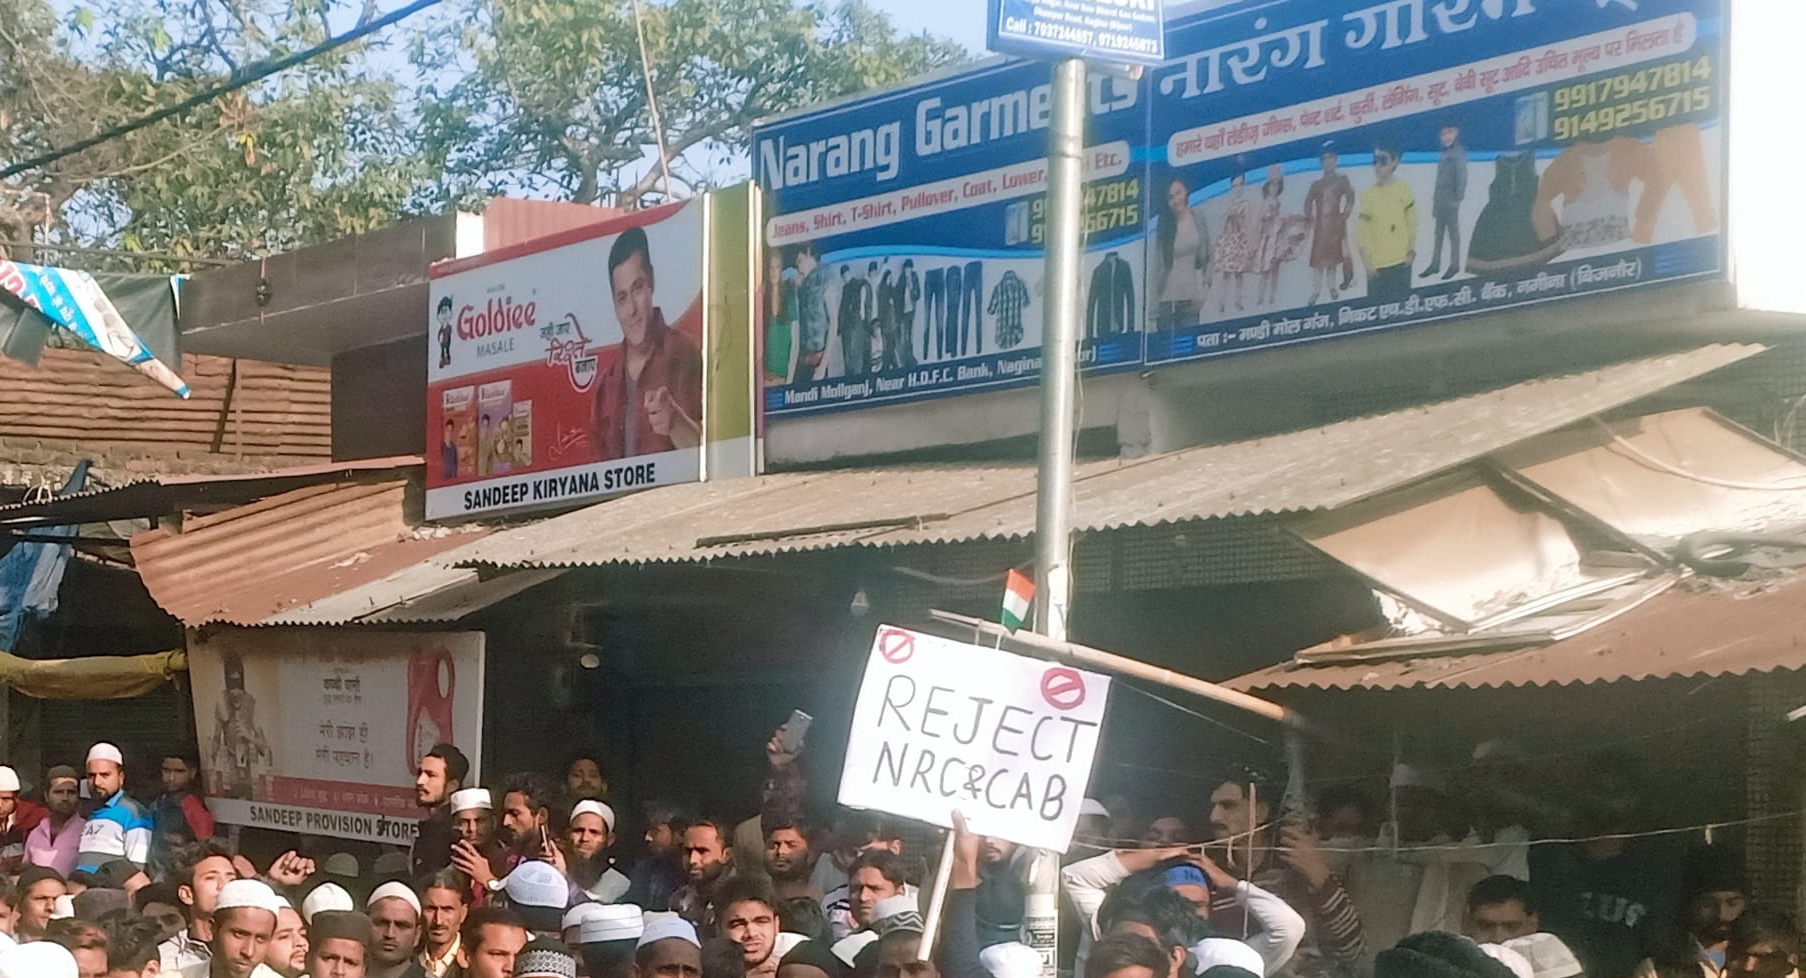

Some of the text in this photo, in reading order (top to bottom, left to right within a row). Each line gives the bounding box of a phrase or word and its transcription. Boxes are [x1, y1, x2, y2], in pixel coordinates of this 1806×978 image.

[1006, 16, 1027, 33] Call
[1604, 40, 1622, 59] पर
[1156, 17, 1330, 99] नारंग
[1554, 56, 1712, 111] 9917947814
[759, 73, 1138, 191] Narang Garmets
[1554, 87, 1711, 140] 9149256715
[771, 218, 810, 240] Jeans,
[813, 210, 847, 231] Shirt,
[850, 200, 897, 223] T-Shirt,
[901, 187, 958, 213] Pullover,
[962, 178, 997, 199] Coat,
[1095, 151, 1123, 170] Etc.
[457, 296, 536, 342] Goldiee
[476, 339, 515, 359] MASALE
[785, 389, 819, 406] Mandi
[876, 376, 905, 393] Near
[907, 368, 954, 388] H.D.F.C.
[957, 363, 994, 382] Bank,
[464, 462, 656, 510] SANDEEP KIRYANA STORE
[877, 674, 1098, 763] REJECT
[872, 741, 1067, 821] NRC&CAB
[250, 805, 302, 828] SANDEEP
[305, 811, 372, 836] PROVISION
